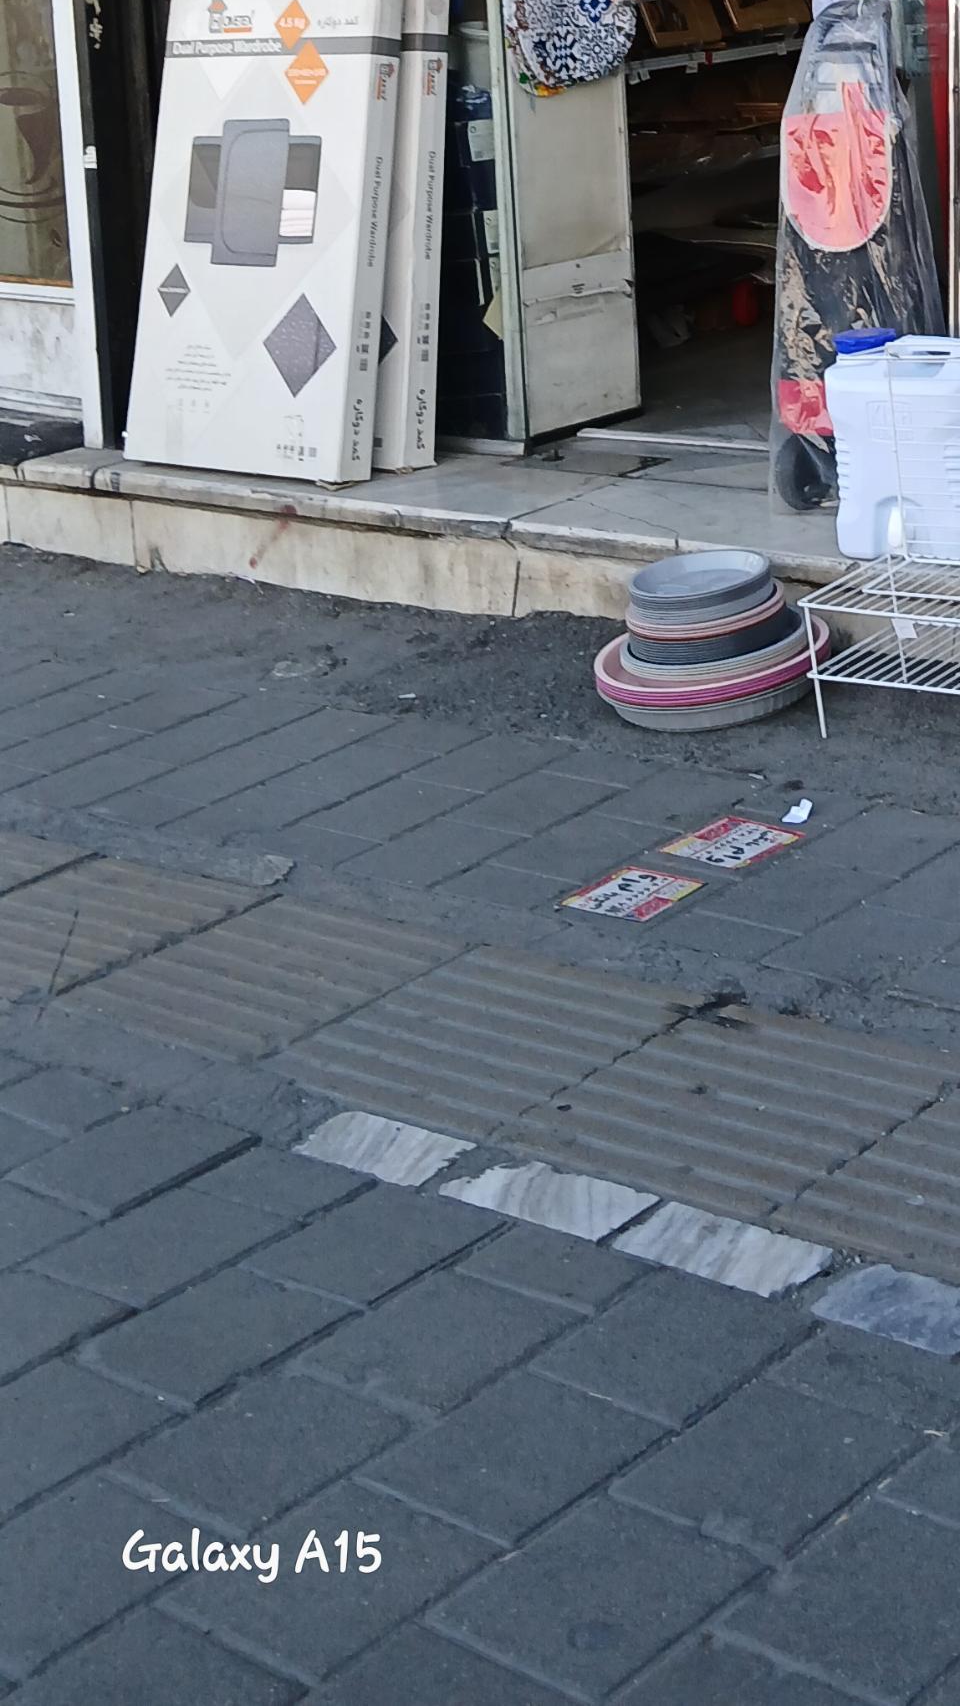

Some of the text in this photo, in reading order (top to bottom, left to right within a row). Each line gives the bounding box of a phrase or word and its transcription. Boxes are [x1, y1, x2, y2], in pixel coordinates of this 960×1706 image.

[172, 40, 282, 57] Dual Purpose Wardrobe
[367, 156, 384, 268] Dual Purpose Wardrobe
[424, 151, 437, 260] Dual Purpose Wardrobe
[351, 398, 364, 462] کمد دوکاره
[416, 389, 427, 450] کمد دوکاره
[617, 874, 658, 894] وام
